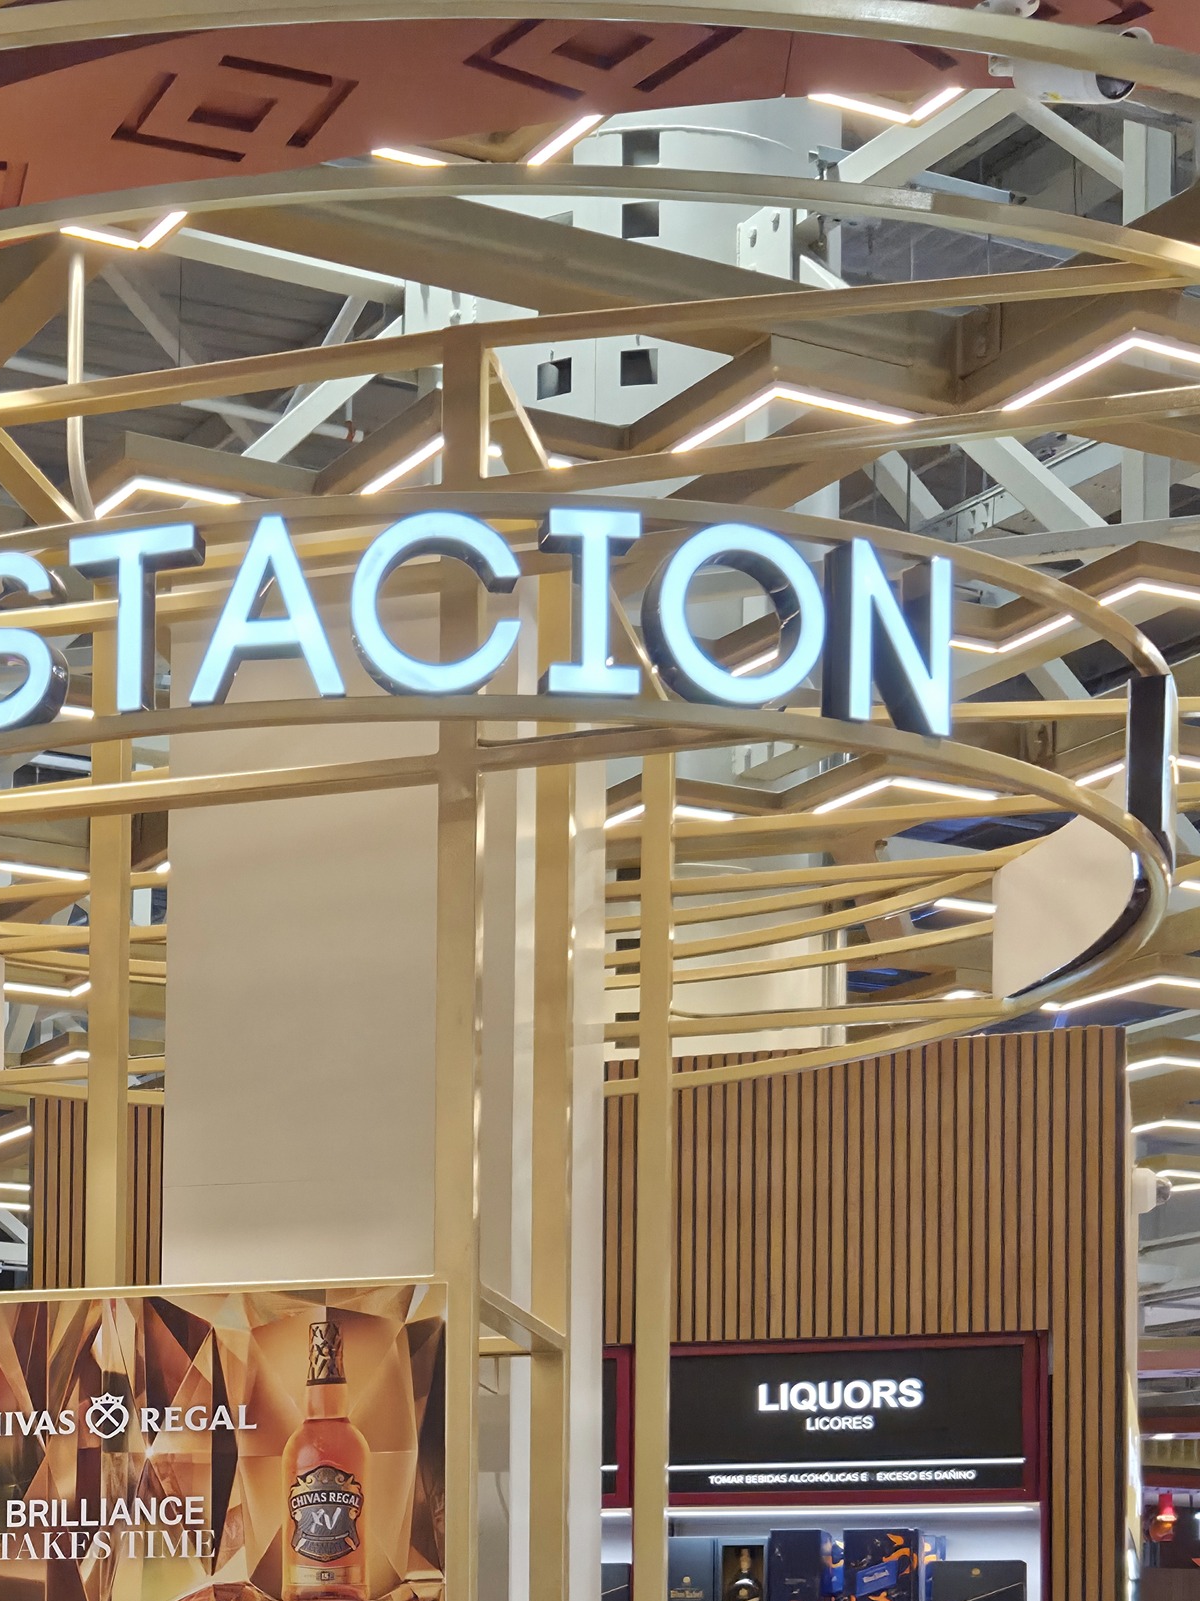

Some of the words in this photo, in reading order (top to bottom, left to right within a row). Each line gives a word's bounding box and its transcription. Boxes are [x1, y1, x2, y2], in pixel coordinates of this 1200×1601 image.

[758, 1378, 924, 1412] LIQUORS
[141, 1404, 257, 1432] REGAL
[806, 1415, 874, 1431] LICORES
[709, 1475, 743, 1484] TOMAR
[746, 1474, 787, 1484] BEBIDAS
[789, 1471, 858, 1483] ALCOHÓLICAS
[877, 1471, 917, 1481] EXCESO
[920, 1471, 932, 1481] ES
[935, 1468, 975, 1480] DAÑINO
[6, 1496, 205, 1527] BRILLIANCE
[292, 1492, 326, 1508] CHIVAS
[329, 1492, 359, 1507] REGAL
[311, 1507, 341, 1533] XV
[121, 1529, 216, 1559] TIME
